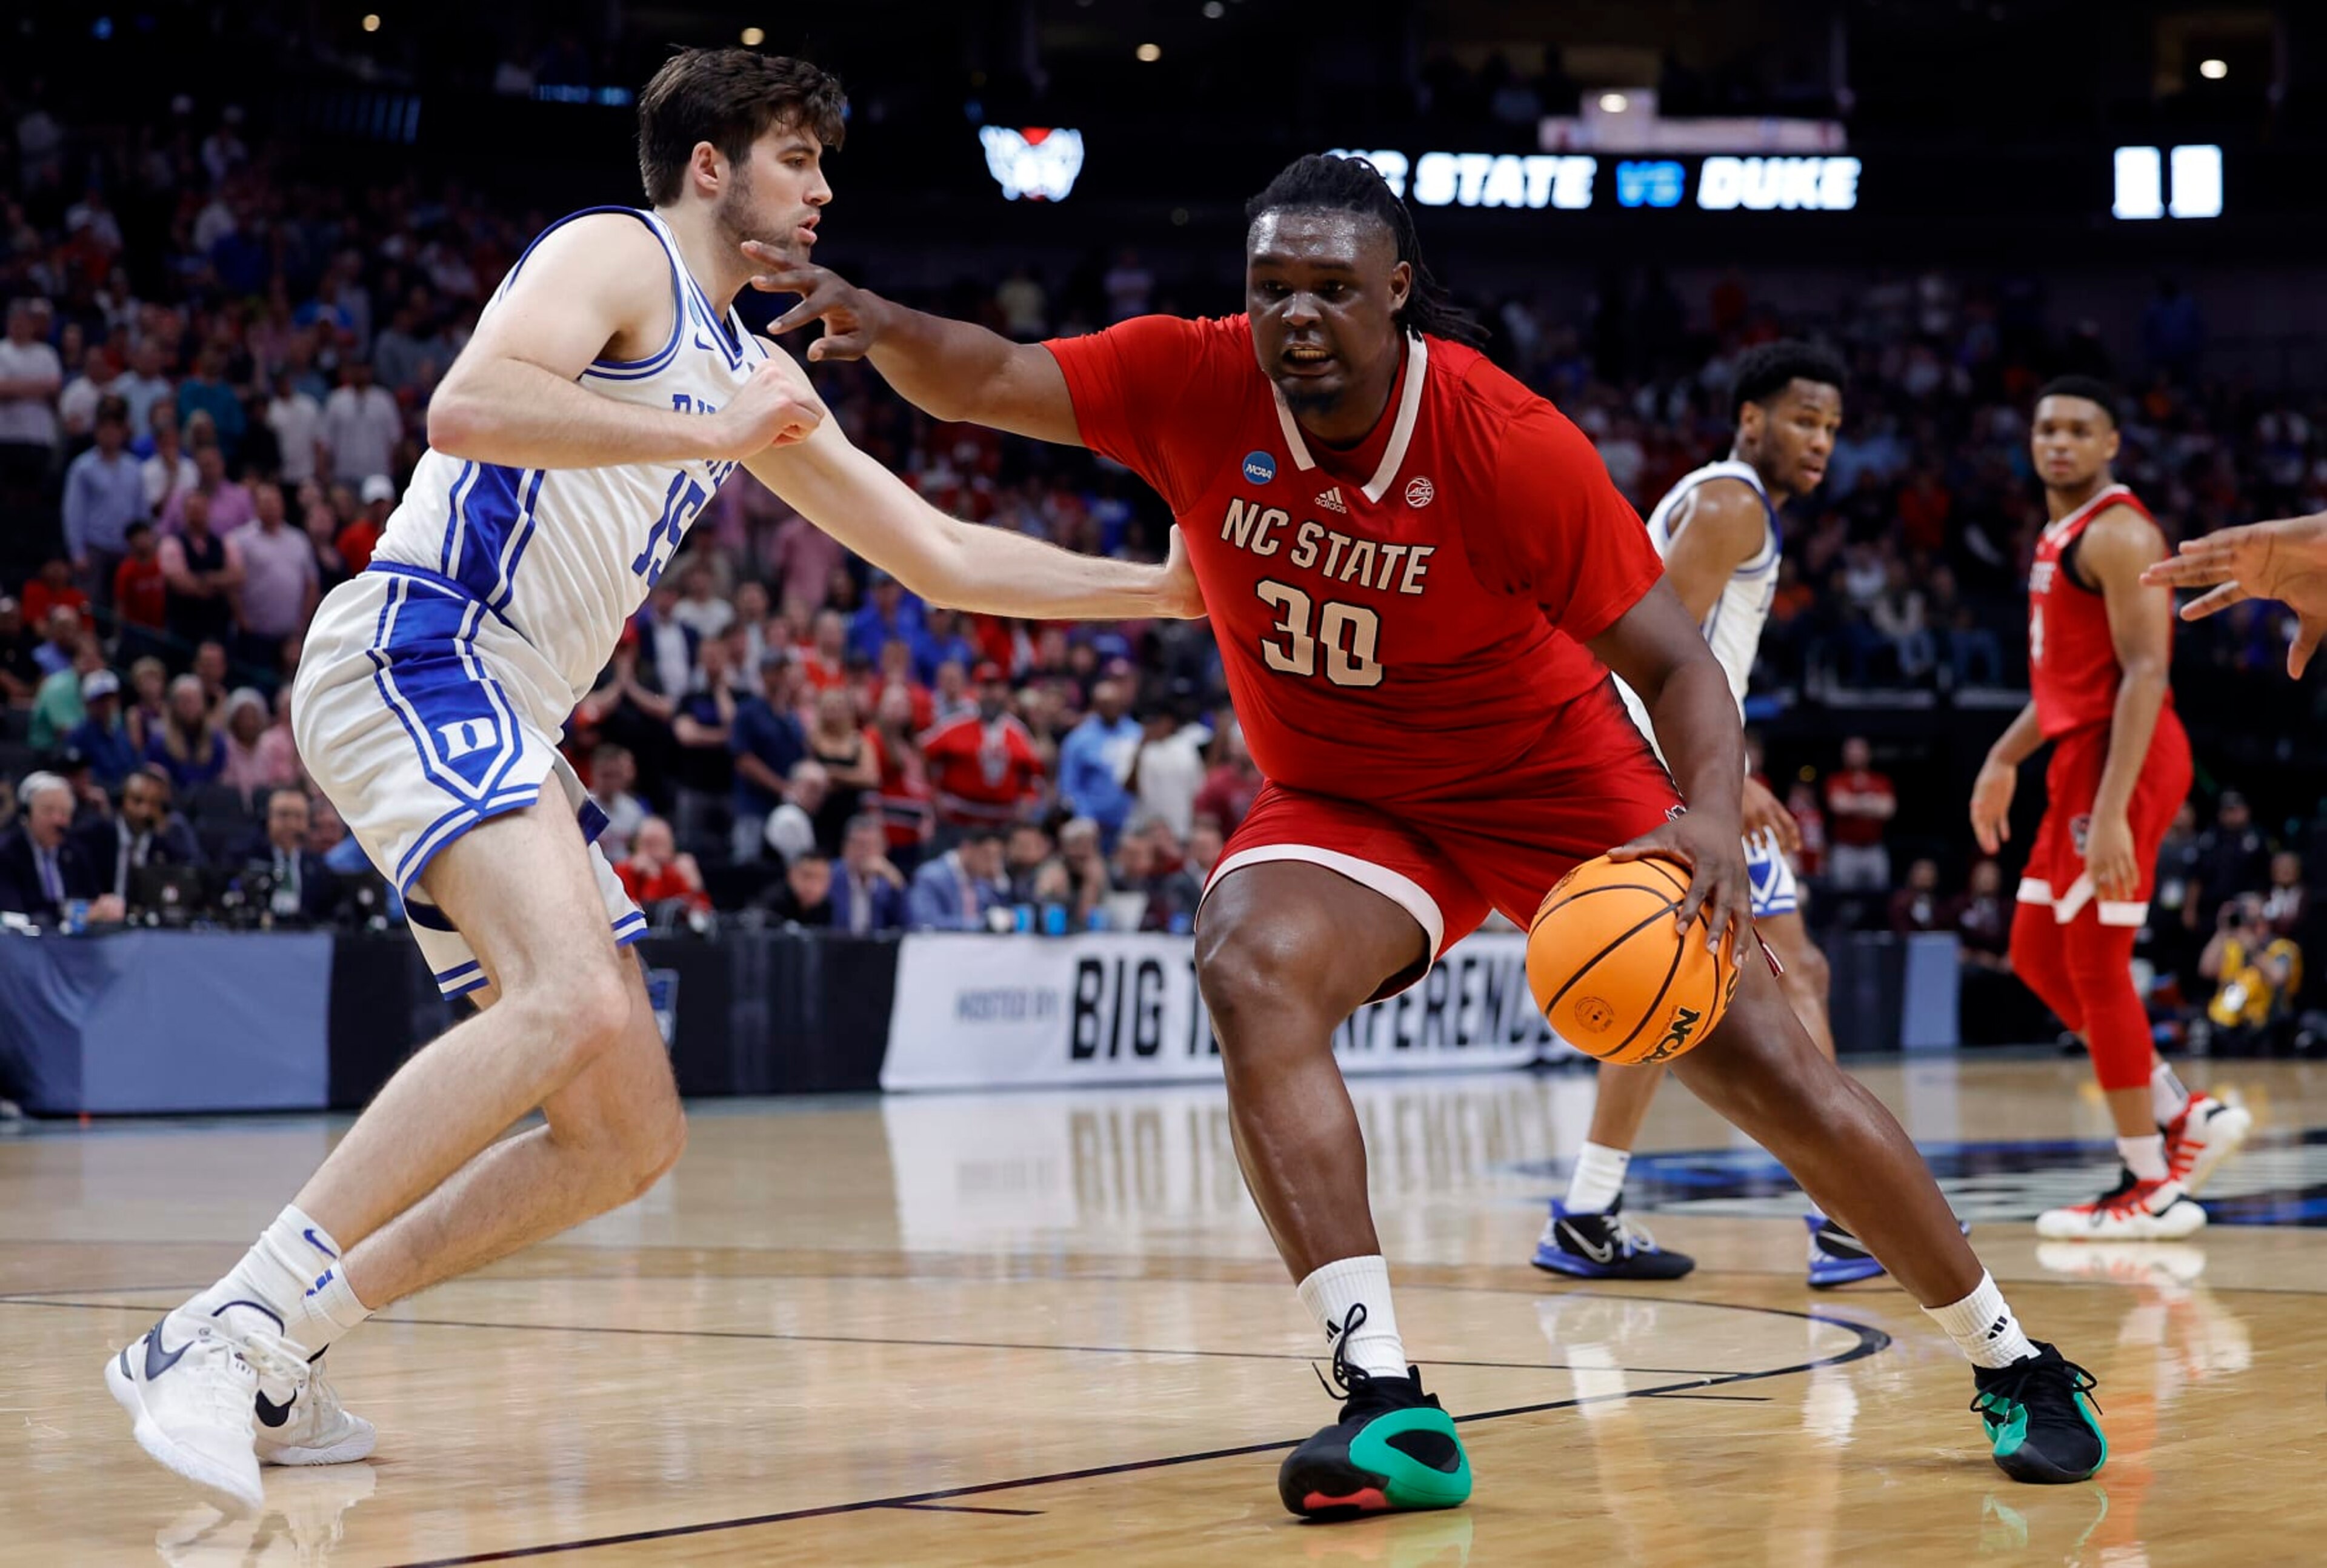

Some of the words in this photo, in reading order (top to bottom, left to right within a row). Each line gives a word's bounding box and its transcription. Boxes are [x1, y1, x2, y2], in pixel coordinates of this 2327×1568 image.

[1326, 149, 1408, 201] C
[1413, 151, 1597, 210] STATE
[1616, 161, 1685, 208] VS
[1697, 156, 1862, 210] DUKE
[1245, 463, 1273, 479] NCAA
[1409, 487, 1431, 496] ACC
[1314, 497, 1347, 514] adidas
[1220, 497, 1290, 556] NC
[1290, 521, 1436, 594] STATE
[1256, 579, 1383, 686] 30
[436, 717, 498, 762] D
[1070, 958, 1164, 1059] BIG
